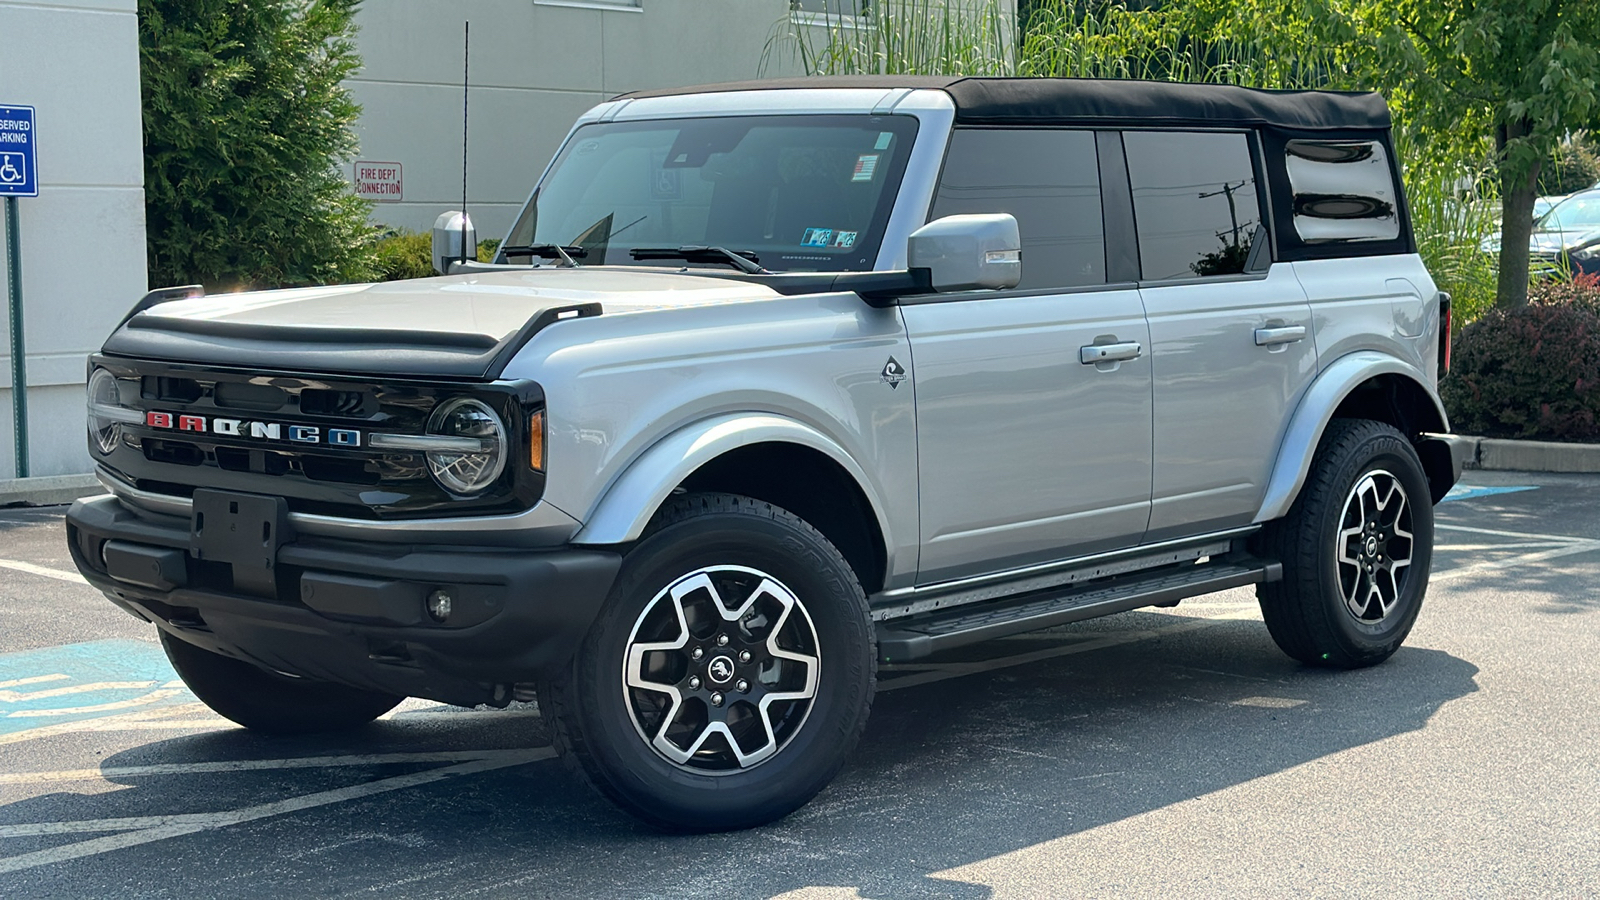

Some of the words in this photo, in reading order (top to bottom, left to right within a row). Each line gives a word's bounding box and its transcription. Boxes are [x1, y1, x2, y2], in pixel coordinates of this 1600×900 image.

[360, 168, 377, 180] FIRE
[378, 168, 396, 180] DEPT
[357, 182, 400, 194] CONNECTION
[146, 410, 361, 447] BRONCO
